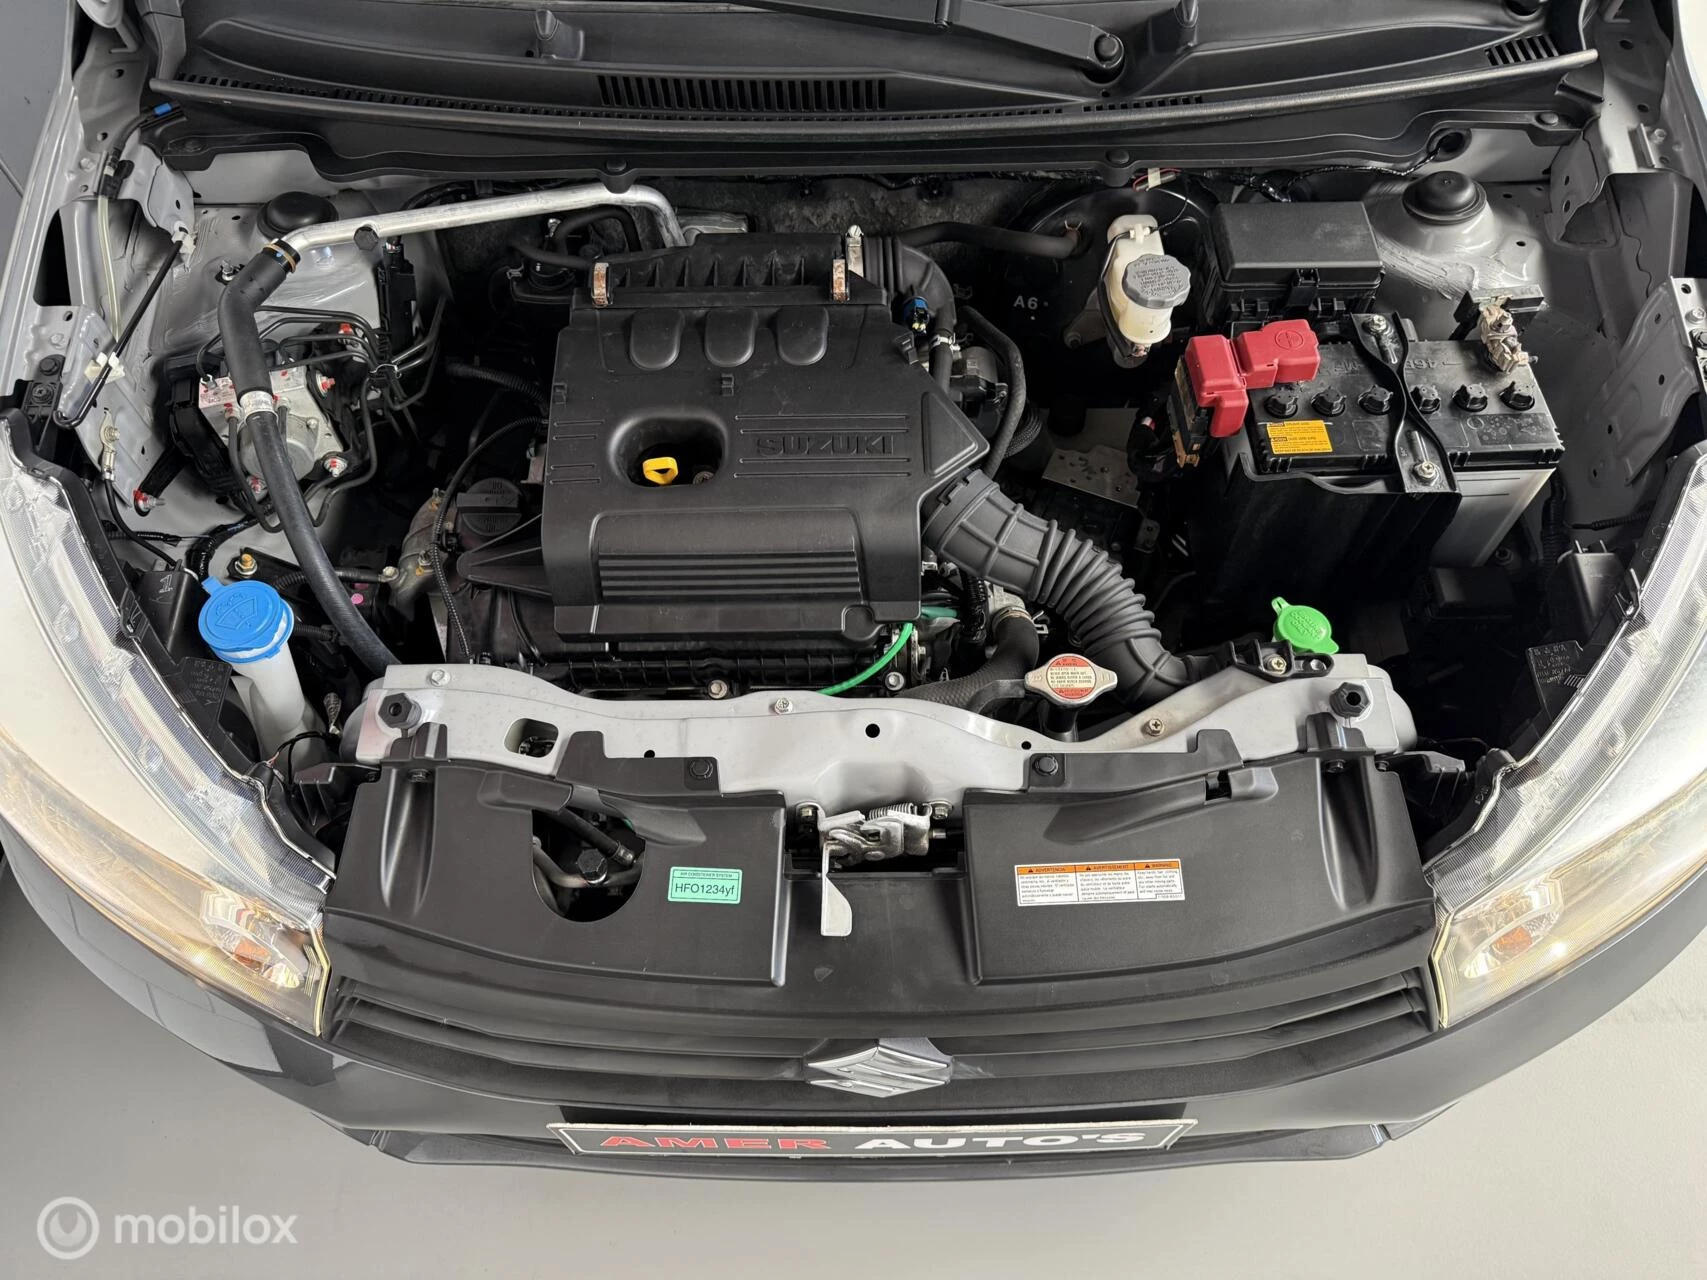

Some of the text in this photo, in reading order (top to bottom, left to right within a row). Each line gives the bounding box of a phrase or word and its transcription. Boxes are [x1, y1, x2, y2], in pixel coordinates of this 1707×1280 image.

[1013, 295, 1038, 310] A6
[757, 435, 894, 457] SUZUKI
[675, 883, 735, 897] HFO1234yf
[600, 1132, 1146, 1149] AMER AUTO'S
